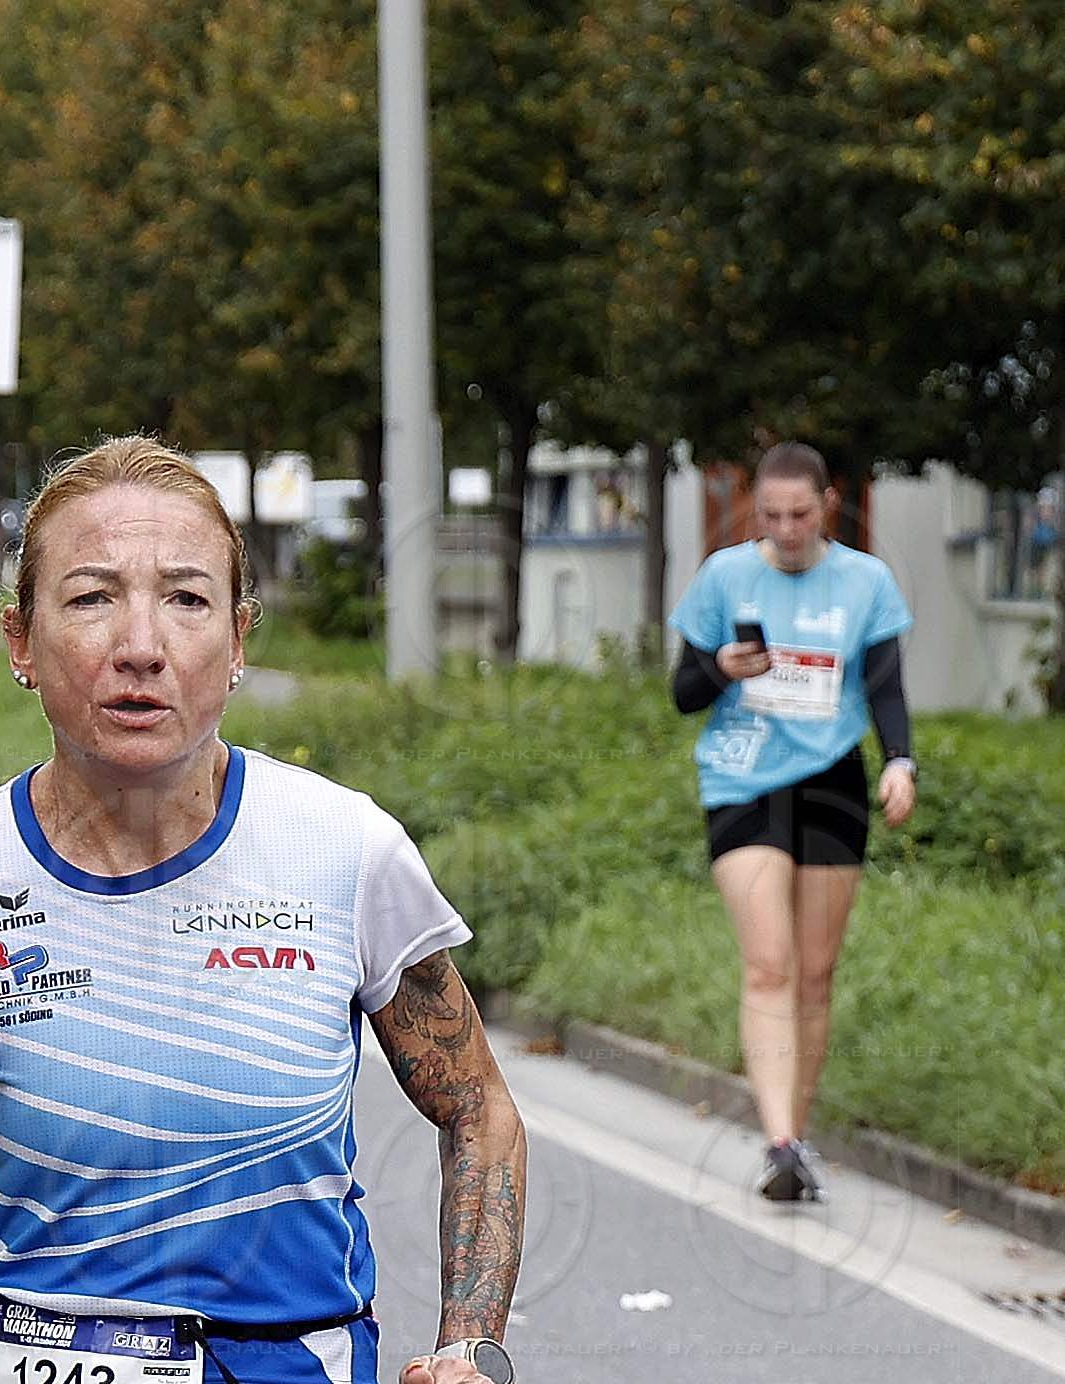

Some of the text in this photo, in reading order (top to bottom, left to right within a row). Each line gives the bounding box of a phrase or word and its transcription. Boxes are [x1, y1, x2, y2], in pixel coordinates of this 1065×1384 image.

[31, 968, 92, 990] PARTNER
[6, 1304, 36, 1320] GRAZ
[3, 1318, 76, 1340] MARATHON
[115, 1333, 171, 1352] GRAZ
